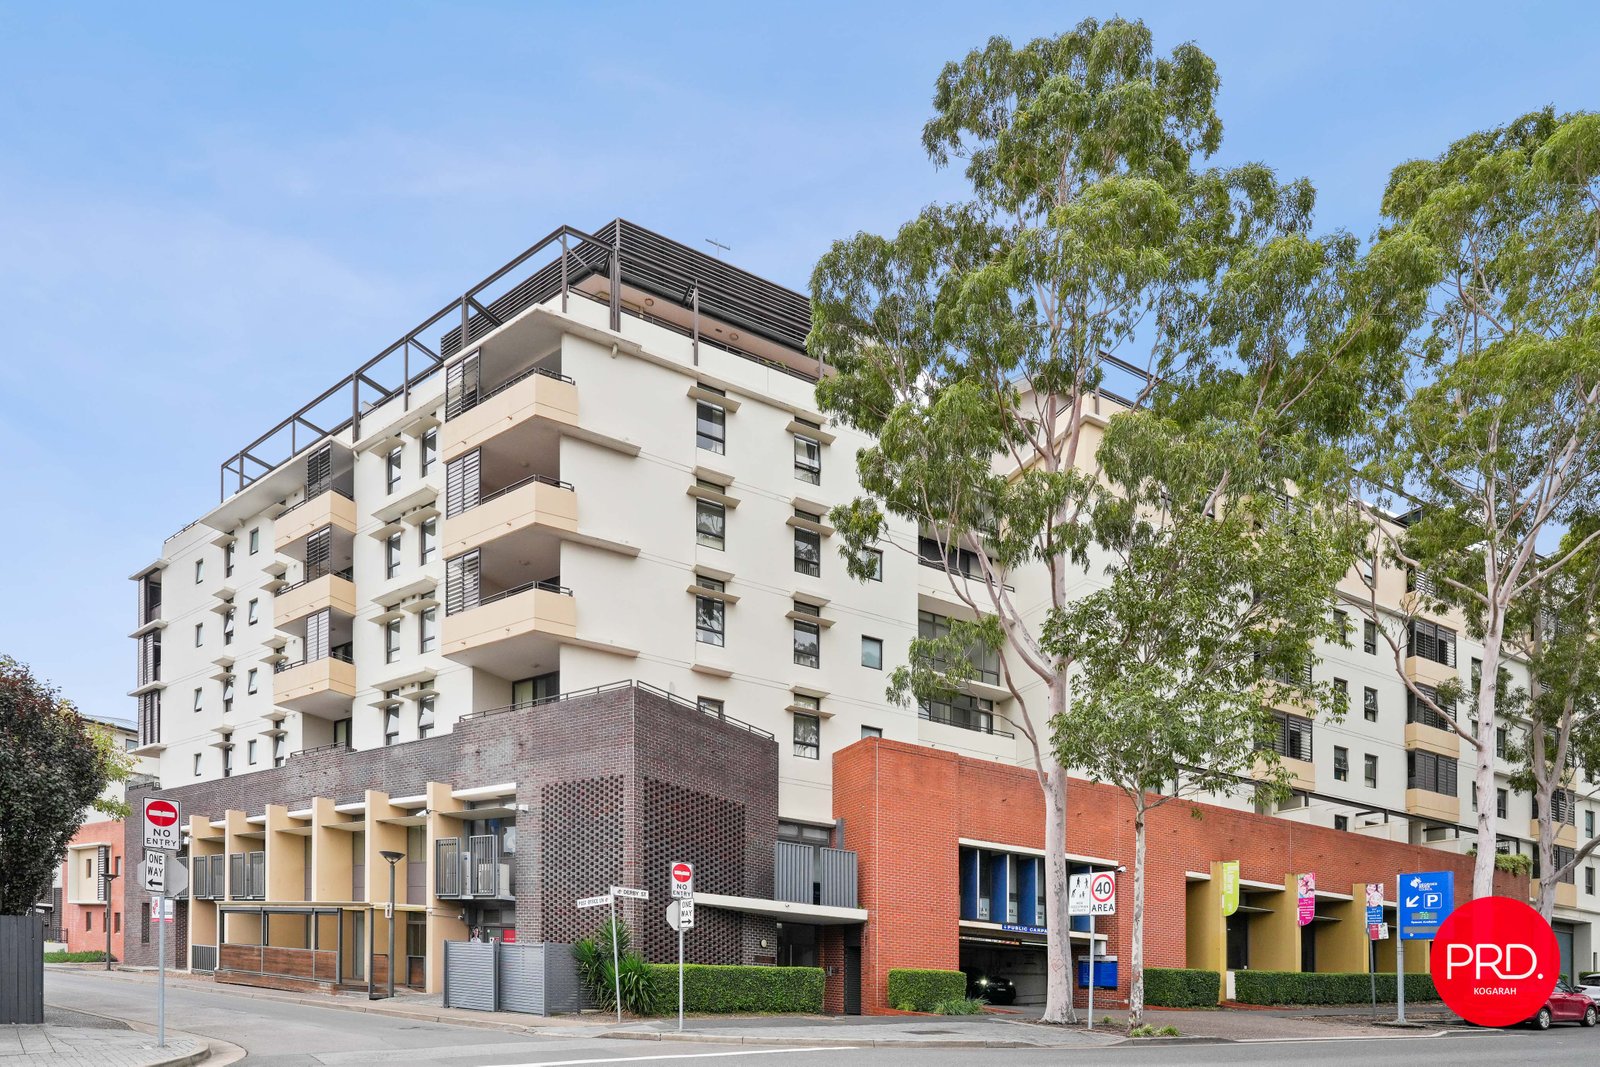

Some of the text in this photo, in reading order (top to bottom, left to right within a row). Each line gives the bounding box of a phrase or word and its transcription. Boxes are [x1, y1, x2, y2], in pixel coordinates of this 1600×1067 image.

[153, 828, 171, 838] NO
[146, 837, 177, 847] ENTRY
[148, 853, 163, 865] ONE
[147, 865, 164, 878] WAY
[1095, 881, 1111, 895] 40
[682, 900, 692, 908] ONE
[1427, 894, 1439, 907] P
[1092, 903, 1115, 912] AREA
[681, 909, 693, 917] WAY
